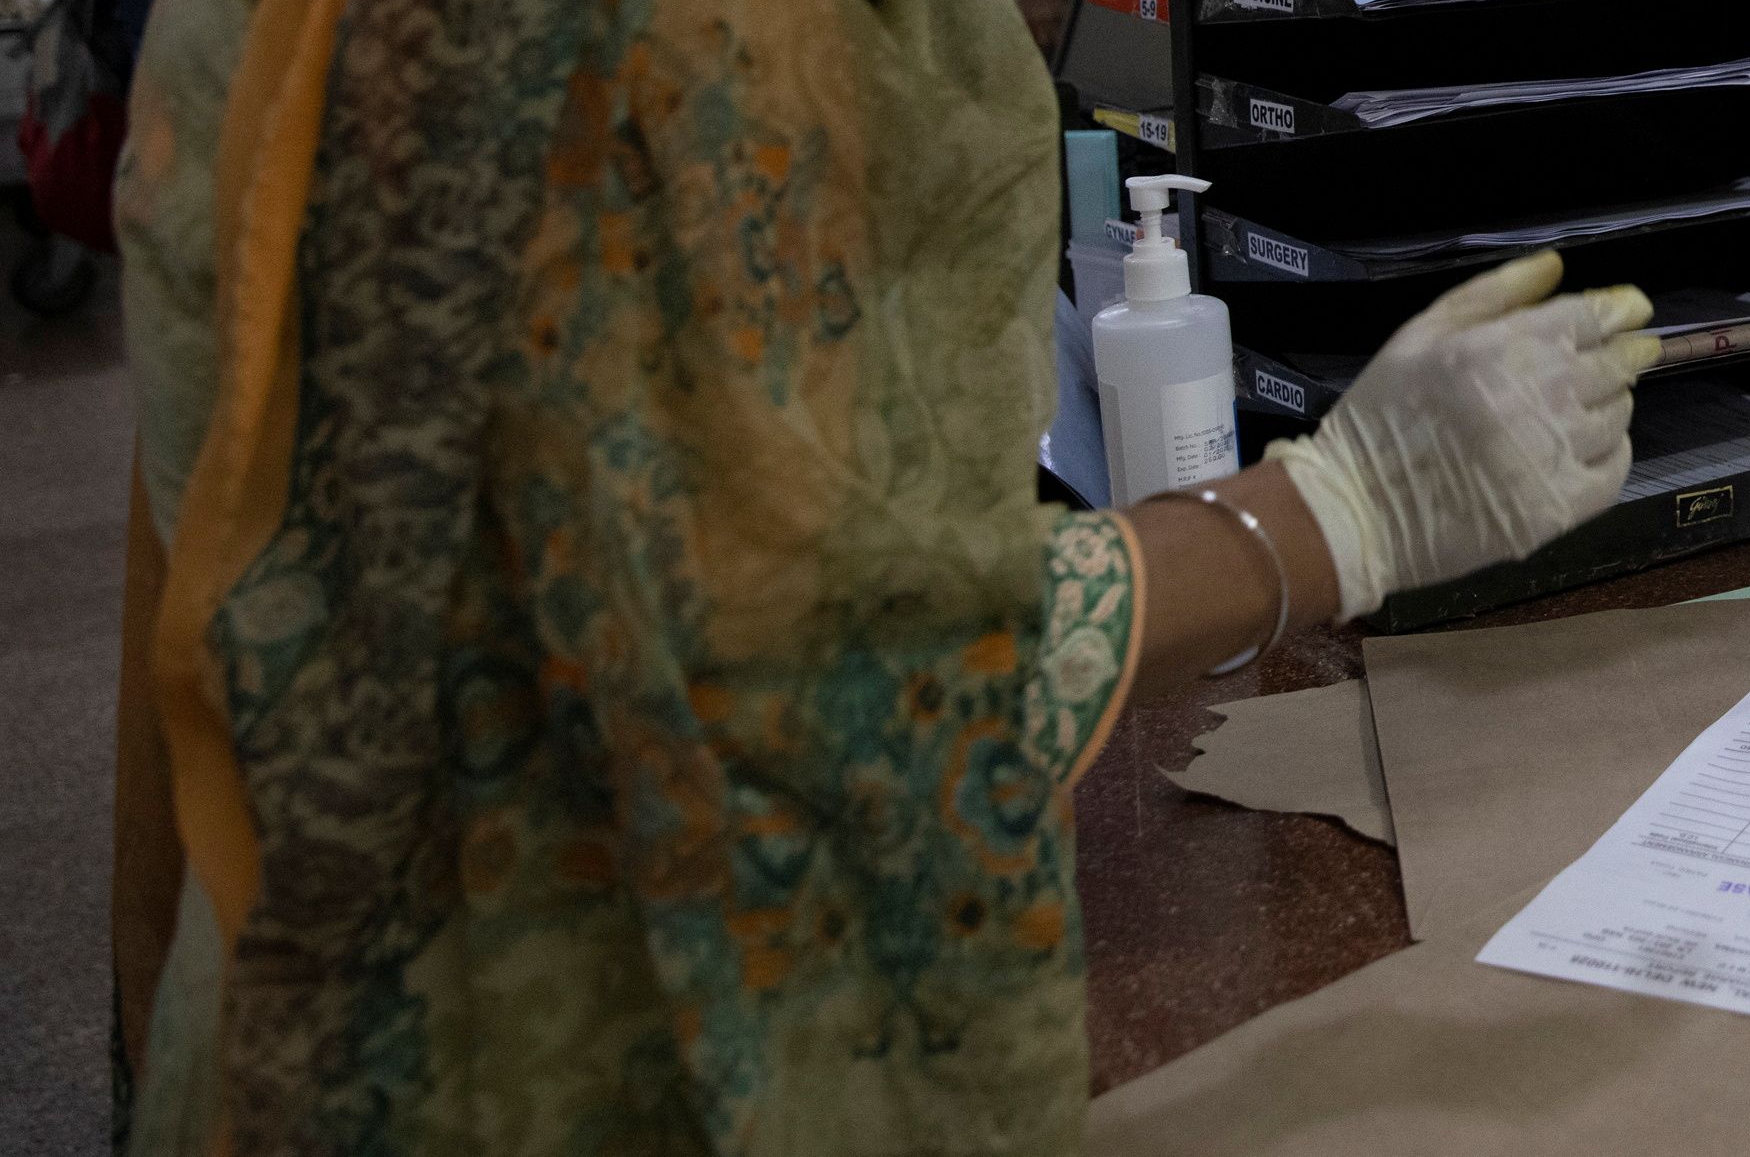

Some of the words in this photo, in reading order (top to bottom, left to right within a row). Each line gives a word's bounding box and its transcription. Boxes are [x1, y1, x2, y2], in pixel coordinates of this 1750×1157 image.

[1250, 104, 1293, 129] ORTHO
[1139, 122, 1168, 142] 15-19
[1249, 236, 1308, 271] SURGERY
[1257, 375, 1304, 409] CARDIO
